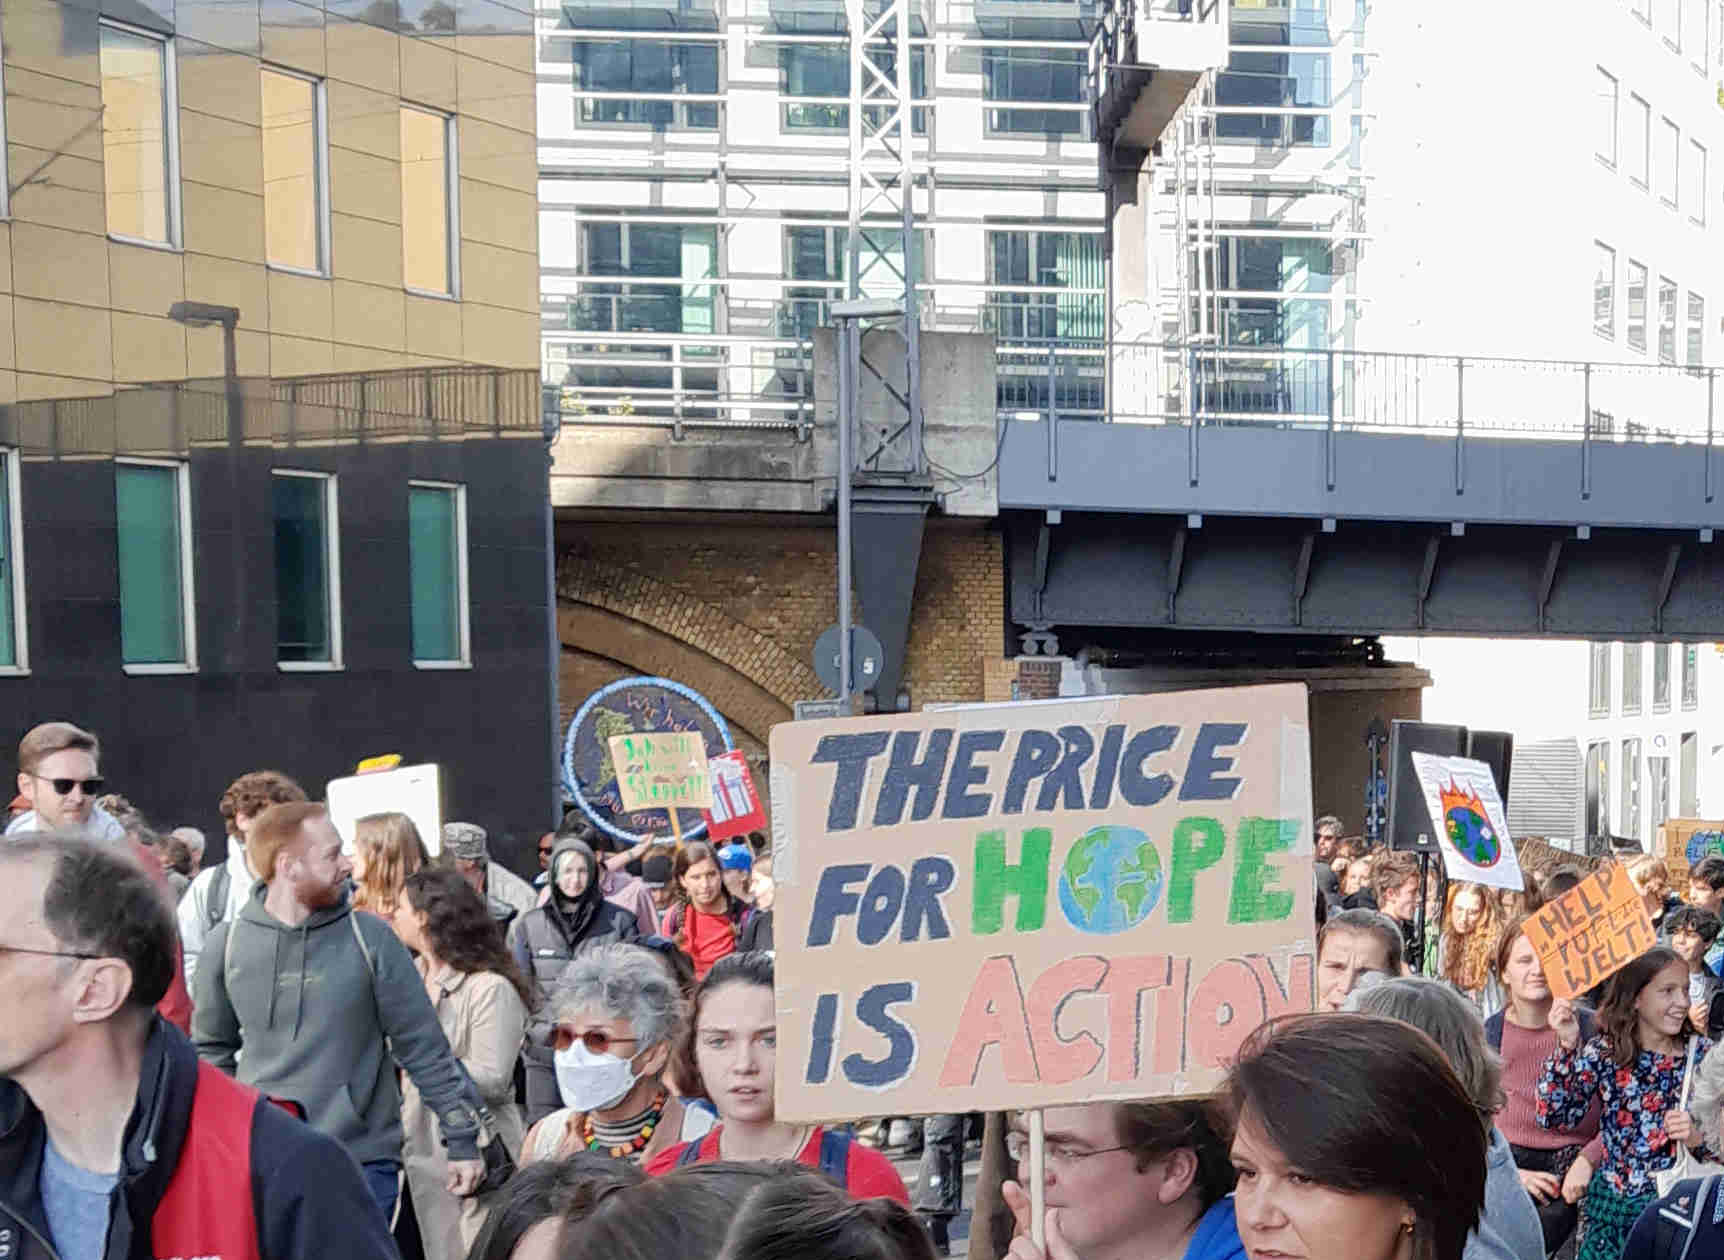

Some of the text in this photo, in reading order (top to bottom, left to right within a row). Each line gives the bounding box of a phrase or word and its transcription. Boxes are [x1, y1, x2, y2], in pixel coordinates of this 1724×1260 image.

[810, 722, 1249, 833] THE PRICE
[805, 816, 1301, 948] FOR HOPE
[805, 980, 918, 1089] IS
